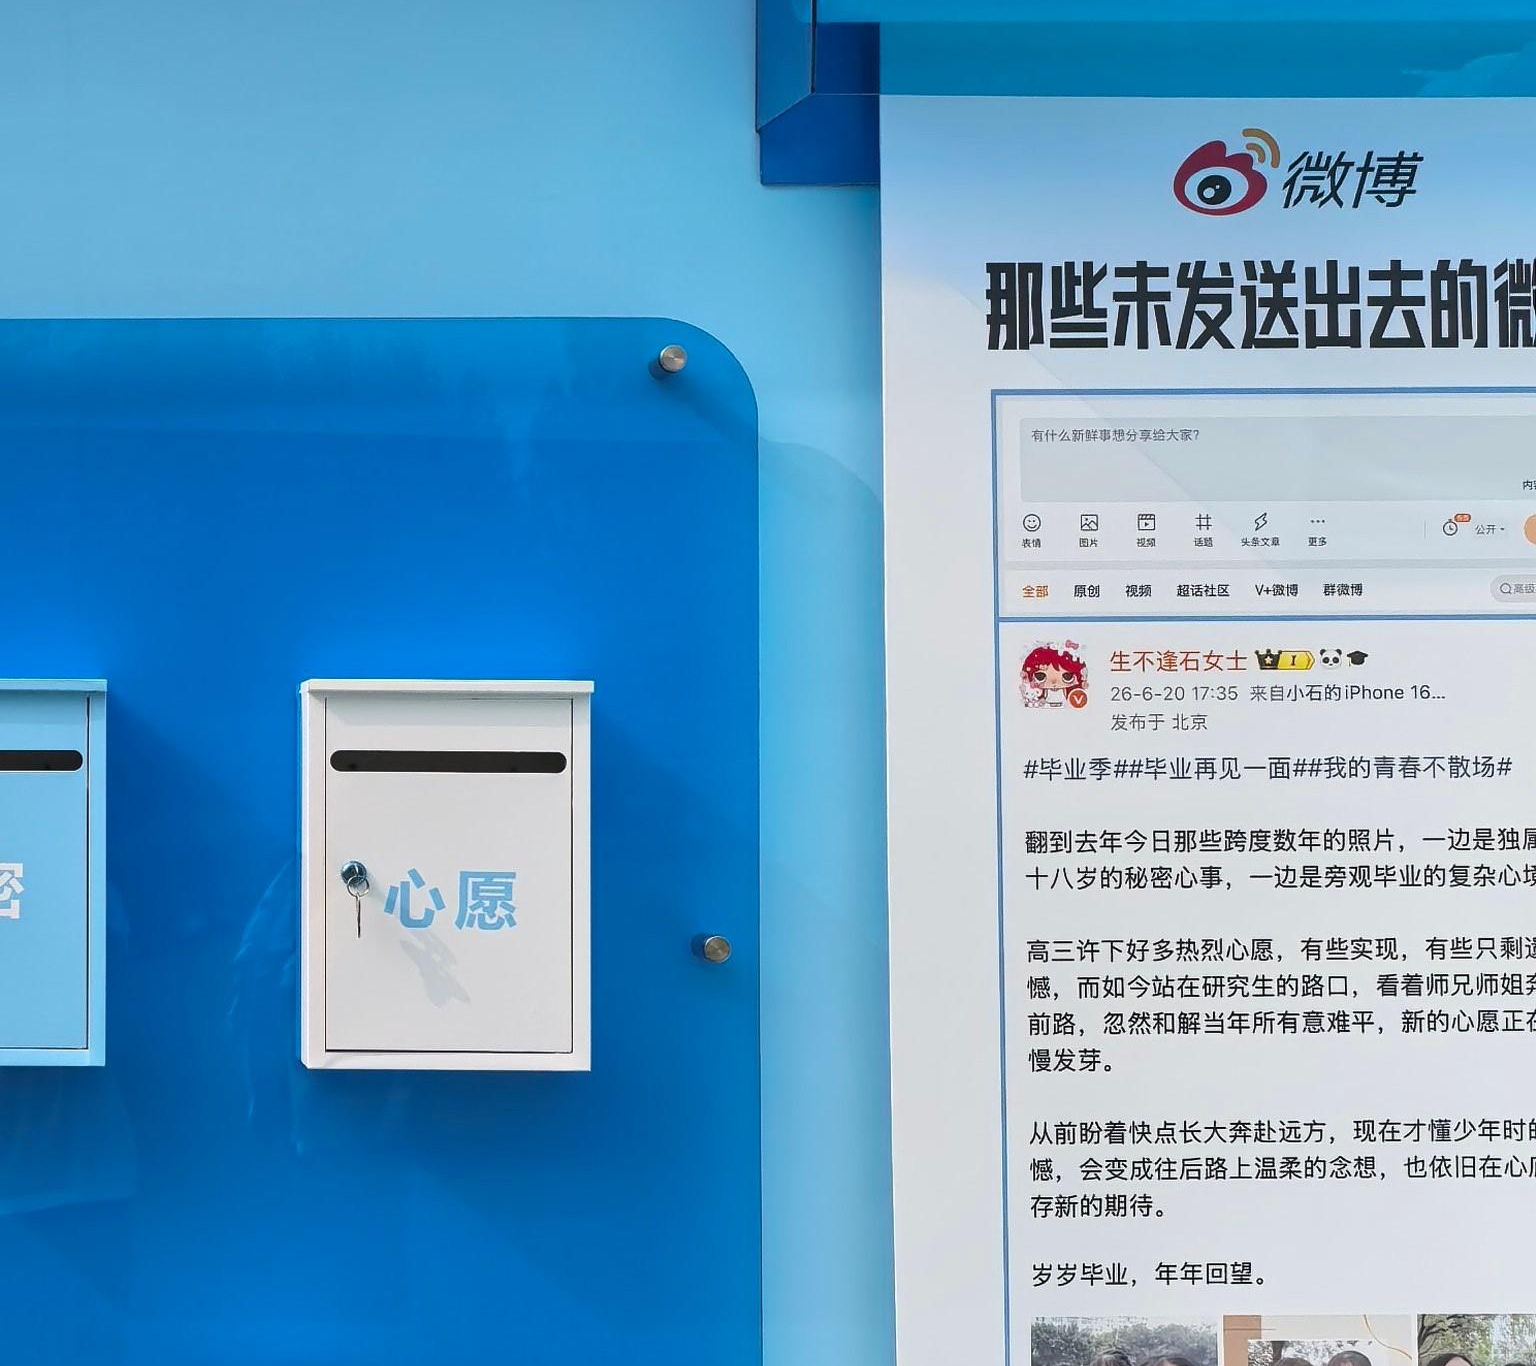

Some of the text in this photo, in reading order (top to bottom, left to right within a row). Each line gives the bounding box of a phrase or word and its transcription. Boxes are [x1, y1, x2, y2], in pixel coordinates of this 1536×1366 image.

[1283, 151, 1424, 208] 微博
[1523, 480, 1536, 490] 内
[1475, 525, 1496, 535] 公开
[1022, 537, 1326, 548] 表情 图片 视频 话题 头条文章 更多
[1023, 586, 1048, 597] 全部
[1074, 585, 1099, 597] 原创
[1126, 585, 1151, 597] 视频
[1177, 584, 1229, 597] 超话社区
[1255, 584, 1298, 596] V+微博
[1324, 583, 1362, 596] 群微博
[1110, 650, 1247, 672] 生不逢石女士
[1111, 687, 1184, 701] 26-6-20
[1192, 686, 1238, 700] 17:35
[1111, 713, 1207, 731] 发布于 北京
[1024, 755, 1512, 781] #毕业季##毕业再见一面##我的青春不散场#
[383, 871, 518, 932] 心愿
[1029, 1048, 1111, 1072] 慢发芽。
[1031, 1194, 1163, 1218] 存新的期待。
[1033, 1262, 1263, 1287] 岁岁毕业，年年回望。
